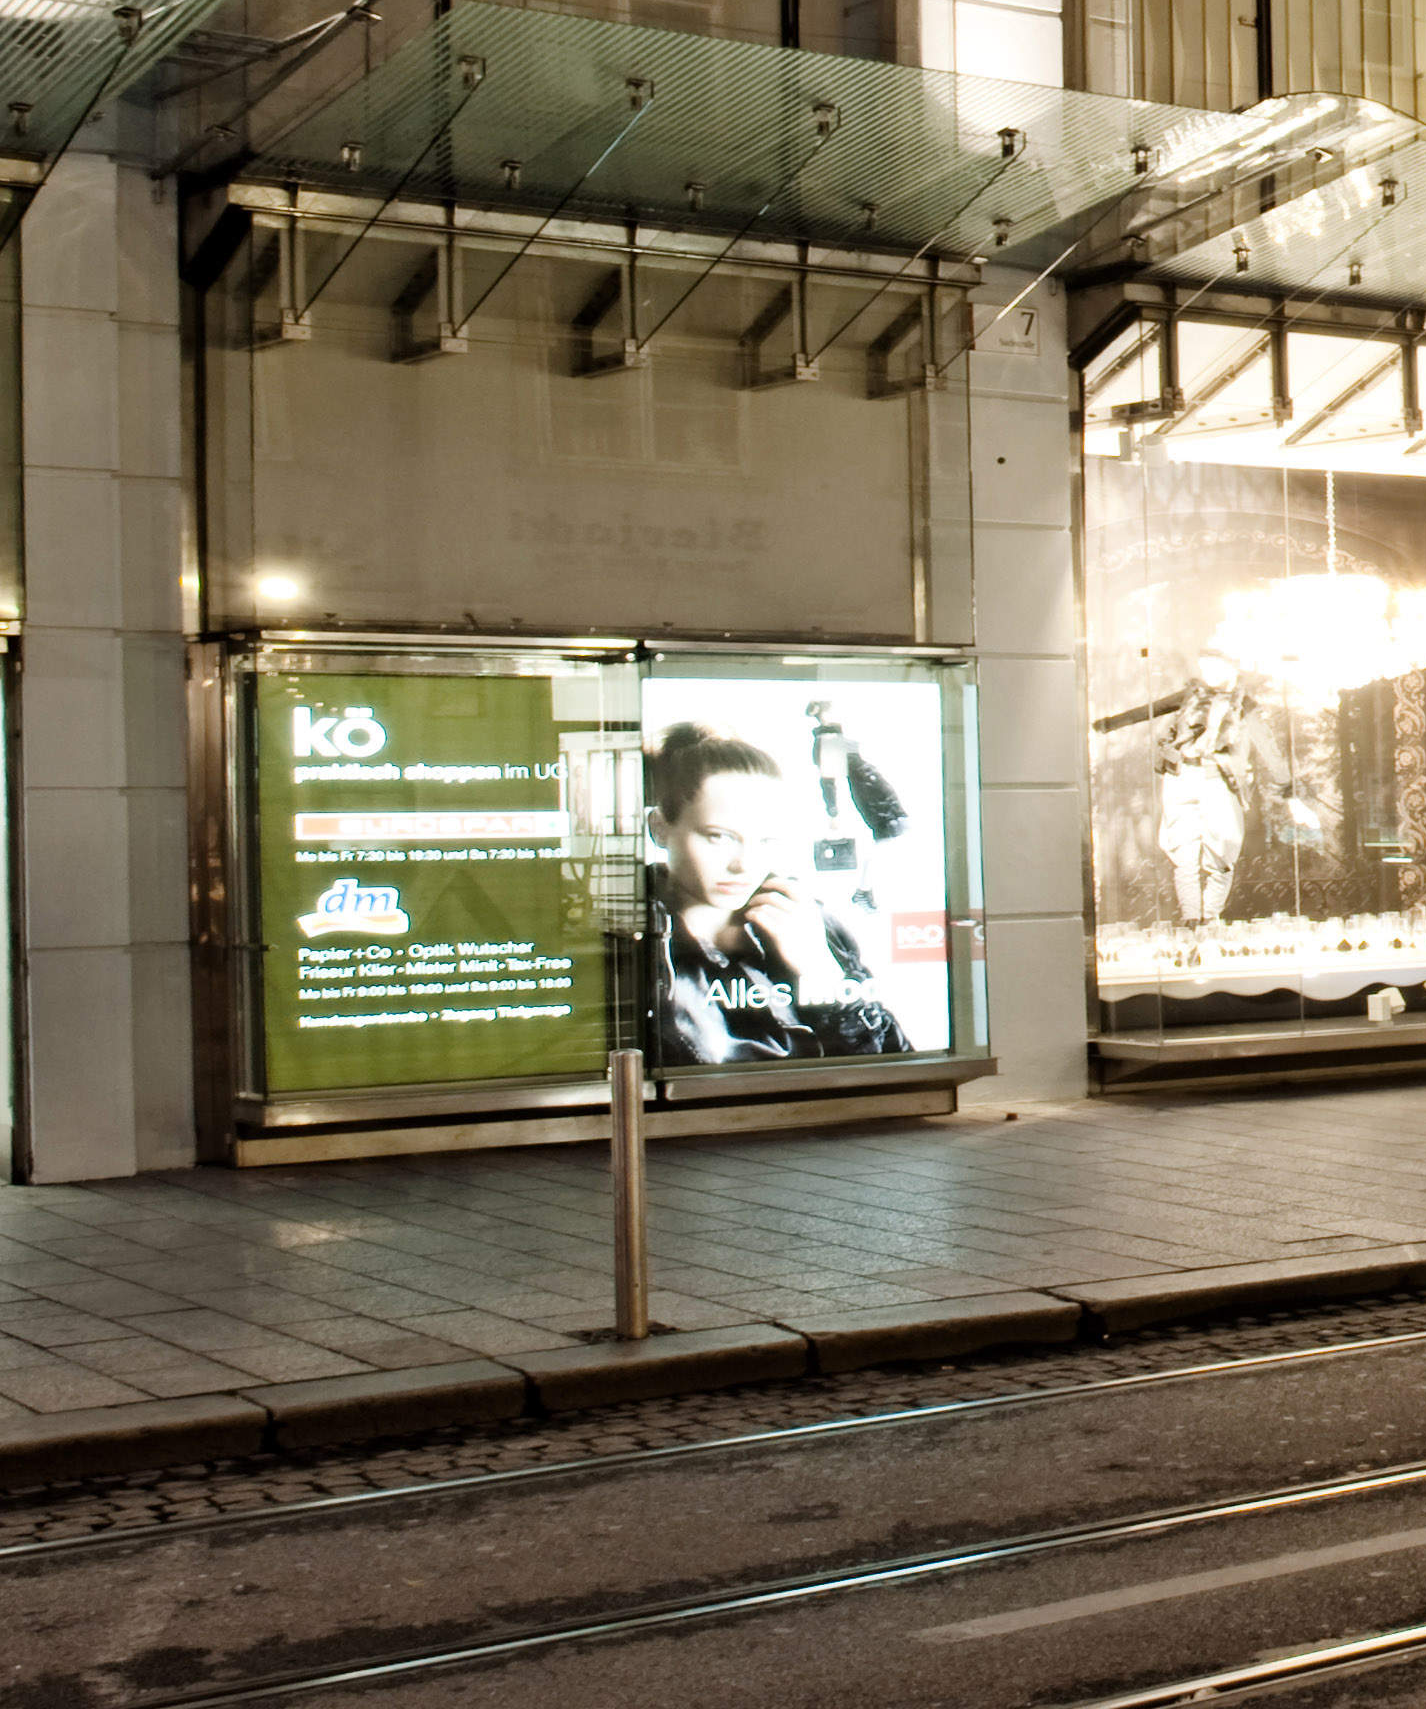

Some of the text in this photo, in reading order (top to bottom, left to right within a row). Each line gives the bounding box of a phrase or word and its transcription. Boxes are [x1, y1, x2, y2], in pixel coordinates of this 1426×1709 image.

[1021, 311, 1035, 336] 7
[295, 763, 568, 784] praktisch shoppen im UG
[295, 851, 317, 862] Mo
[318, 850, 339, 862] bis
[340, 851, 355, 862] Fr
[386, 849, 406, 862] bis
[443, 849, 468, 860] und
[469, 848, 488, 860] Sa
[517, 848, 536, 859] bis
[324, 883, 391, 913] dm
[407, 942, 455, 959] Optik
[456, 940, 535, 957] Wutscher
[298, 964, 356, 980] Friseur
[358, 962, 397, 978] Klier
[404, 960, 457, 977] Mister
[458, 958, 500, 974] Minit
[321, 986, 341, 999] bis
[341, 985, 357, 998] Fr
[387, 984, 407, 997] bis
[444, 981, 469, 994] und
[517, 978, 537, 991] bis
[702, 977, 793, 1009] Alles
